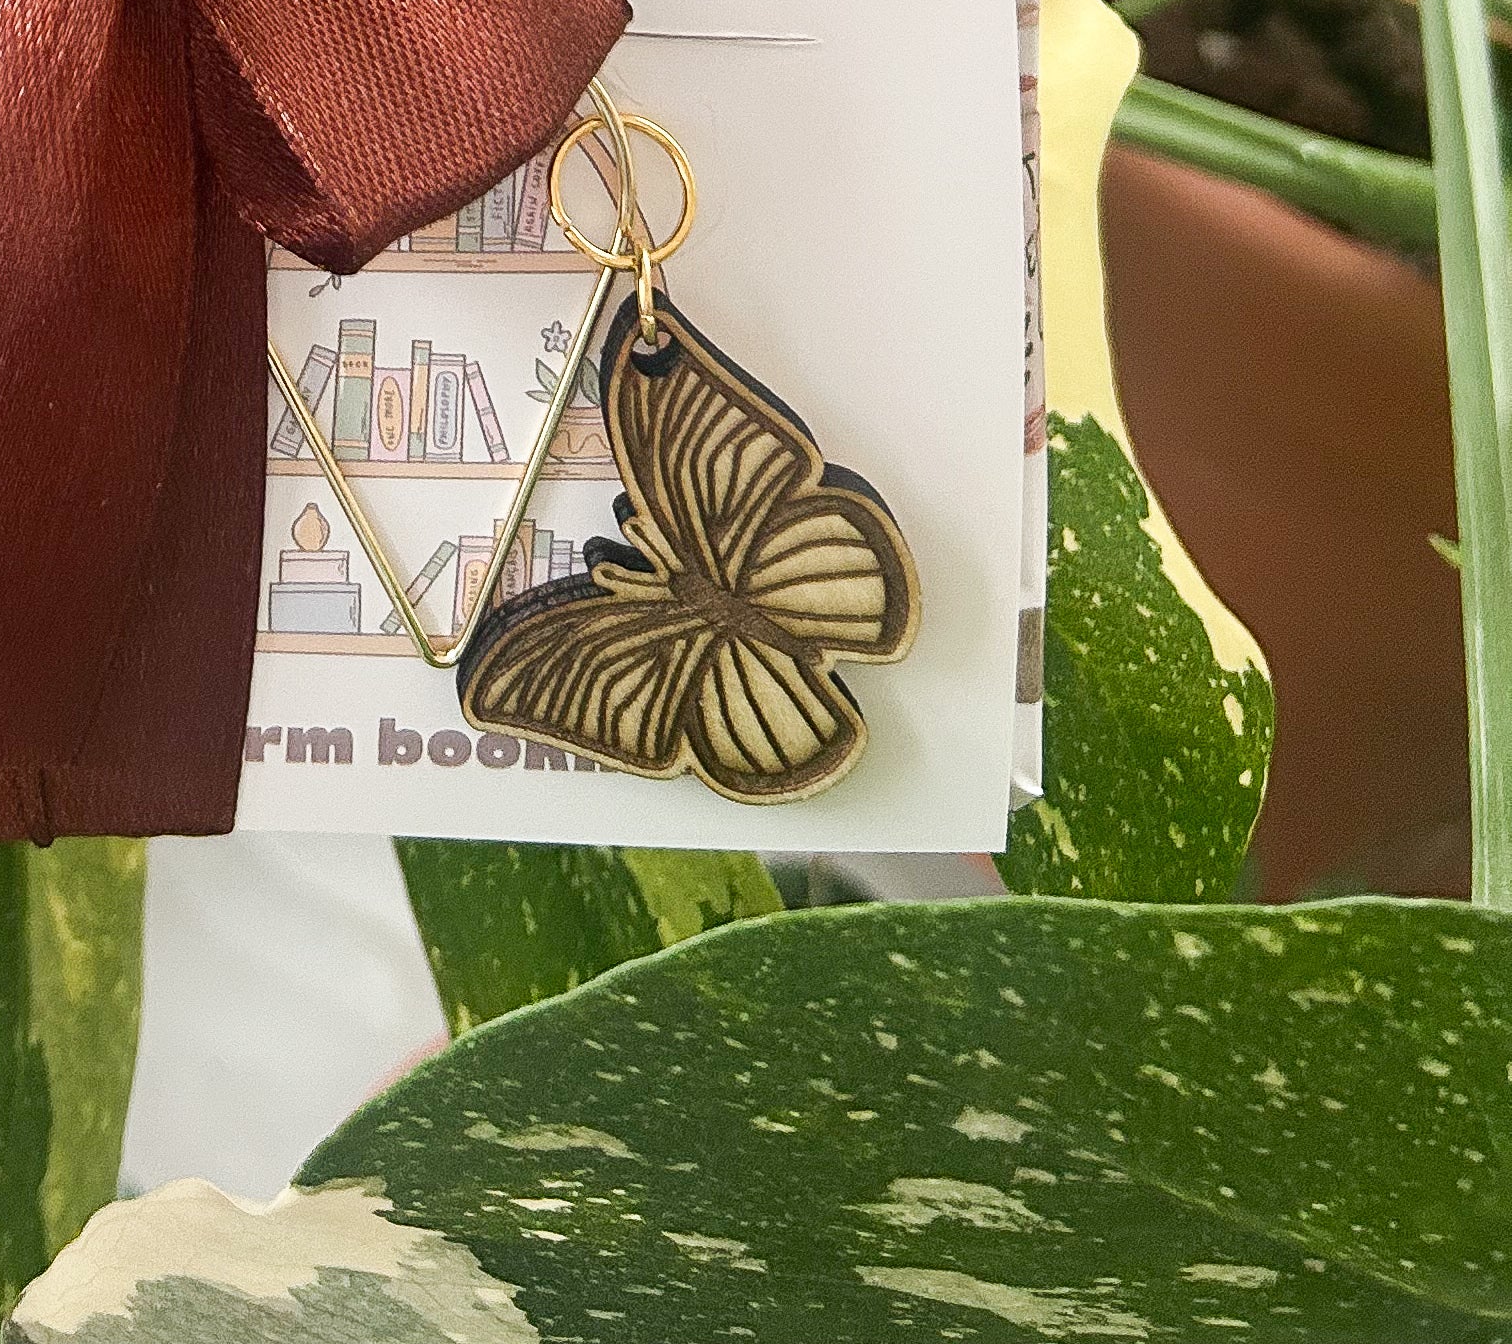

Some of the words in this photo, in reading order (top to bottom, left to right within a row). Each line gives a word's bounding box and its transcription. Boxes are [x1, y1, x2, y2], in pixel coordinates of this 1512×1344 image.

[438, 375, 452, 446] PHILOSOPHY
[245, 725, 354, 765] rm
[378, 717, 623, 773] book
